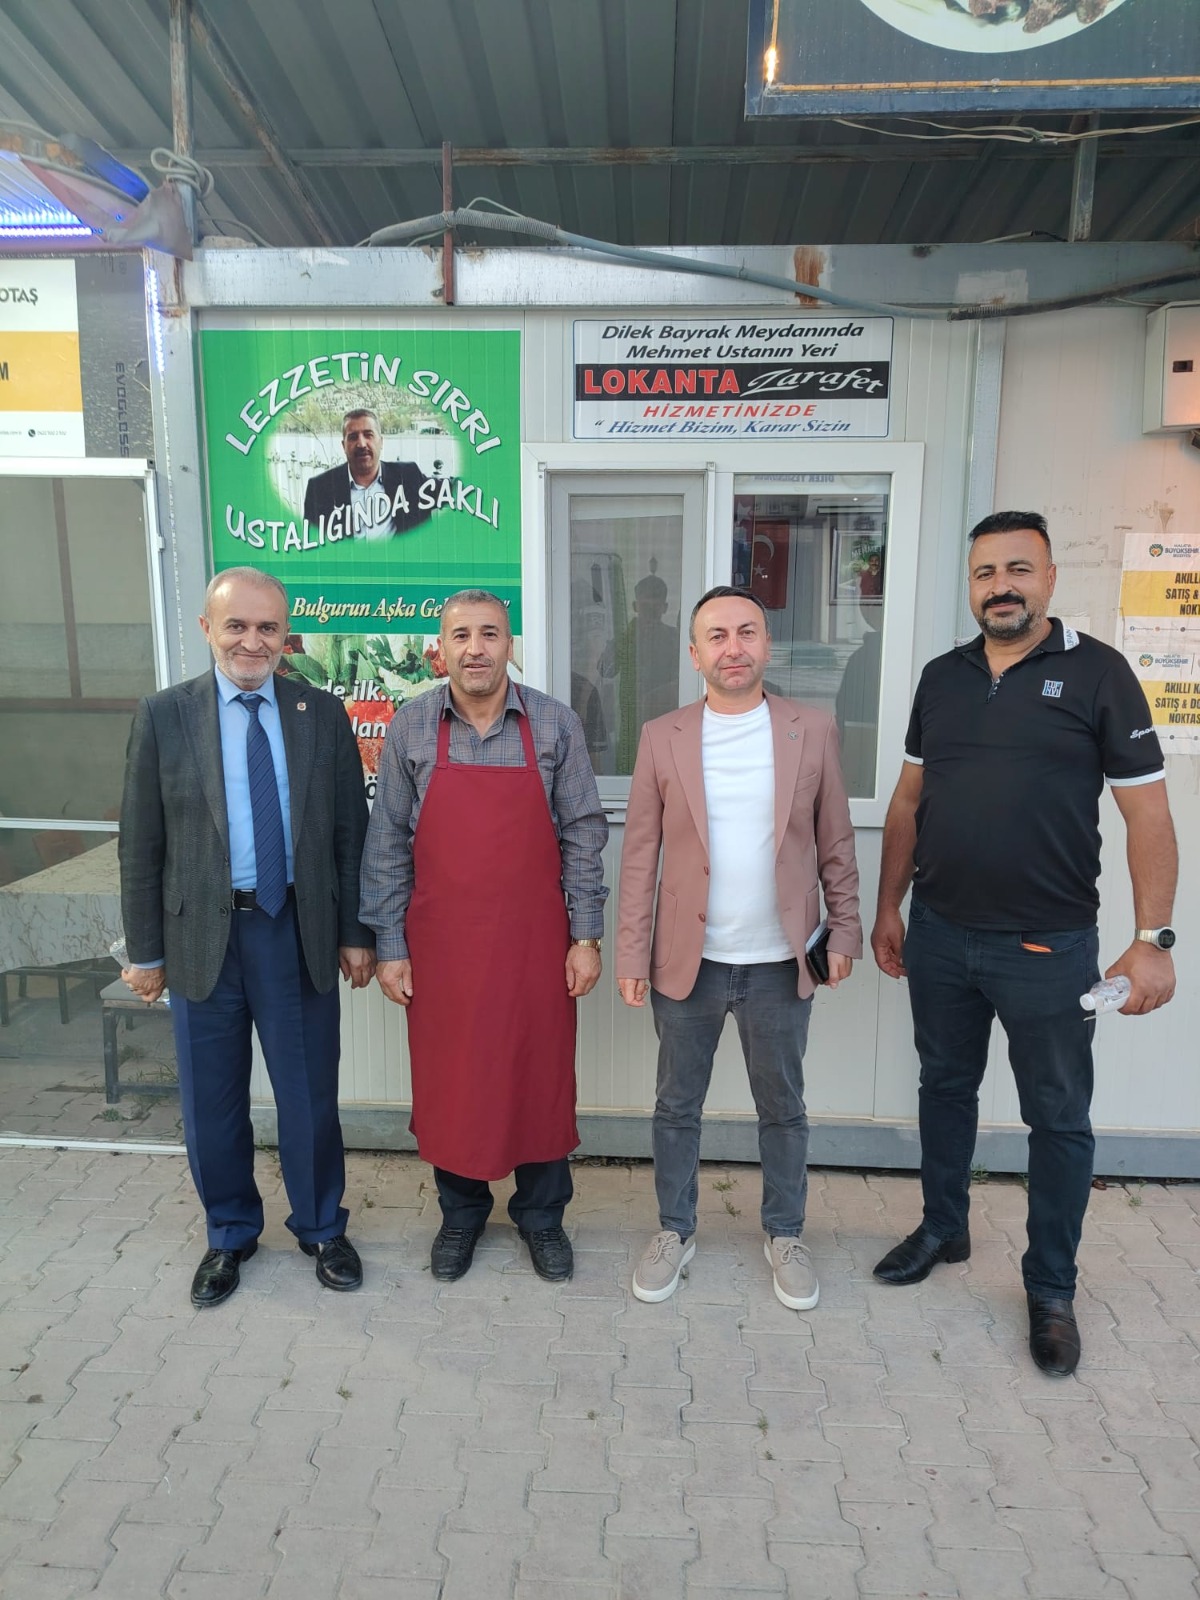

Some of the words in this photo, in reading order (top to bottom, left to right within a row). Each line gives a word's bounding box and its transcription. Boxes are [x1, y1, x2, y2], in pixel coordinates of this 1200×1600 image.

[601, 325, 655, 340] Dilek
[658, 325, 731, 342] Bayrak
[735, 323, 864, 341] Meydanında
[626, 345, 711, 359] Mehmet
[717, 345, 794, 359] Ustanın
[801, 343, 838, 357] Yeri
[584, 369, 740, 395] LOKANTA
[740, 367, 884, 398] Zarafet
[408, 370, 501, 454] SIRRI
[643, 403, 817, 418] HİZMETİNİZDE
[607, 420, 676, 434] Hizmet
[678, 420, 738, 435] Bizim,
[742, 419, 802, 433] Karar
[802, 418, 851, 432] Sizin
[226, 485, 409, 552] USTALIĞINDA
[418, 478, 499, 529] SAKLI
[1165, 588, 1190, 603] SATIŞ
[291, 596, 371, 624] Bulgurun
[372, 597, 416, 623] Aşka
[1155, 697, 1179, 712] SATIŞ
